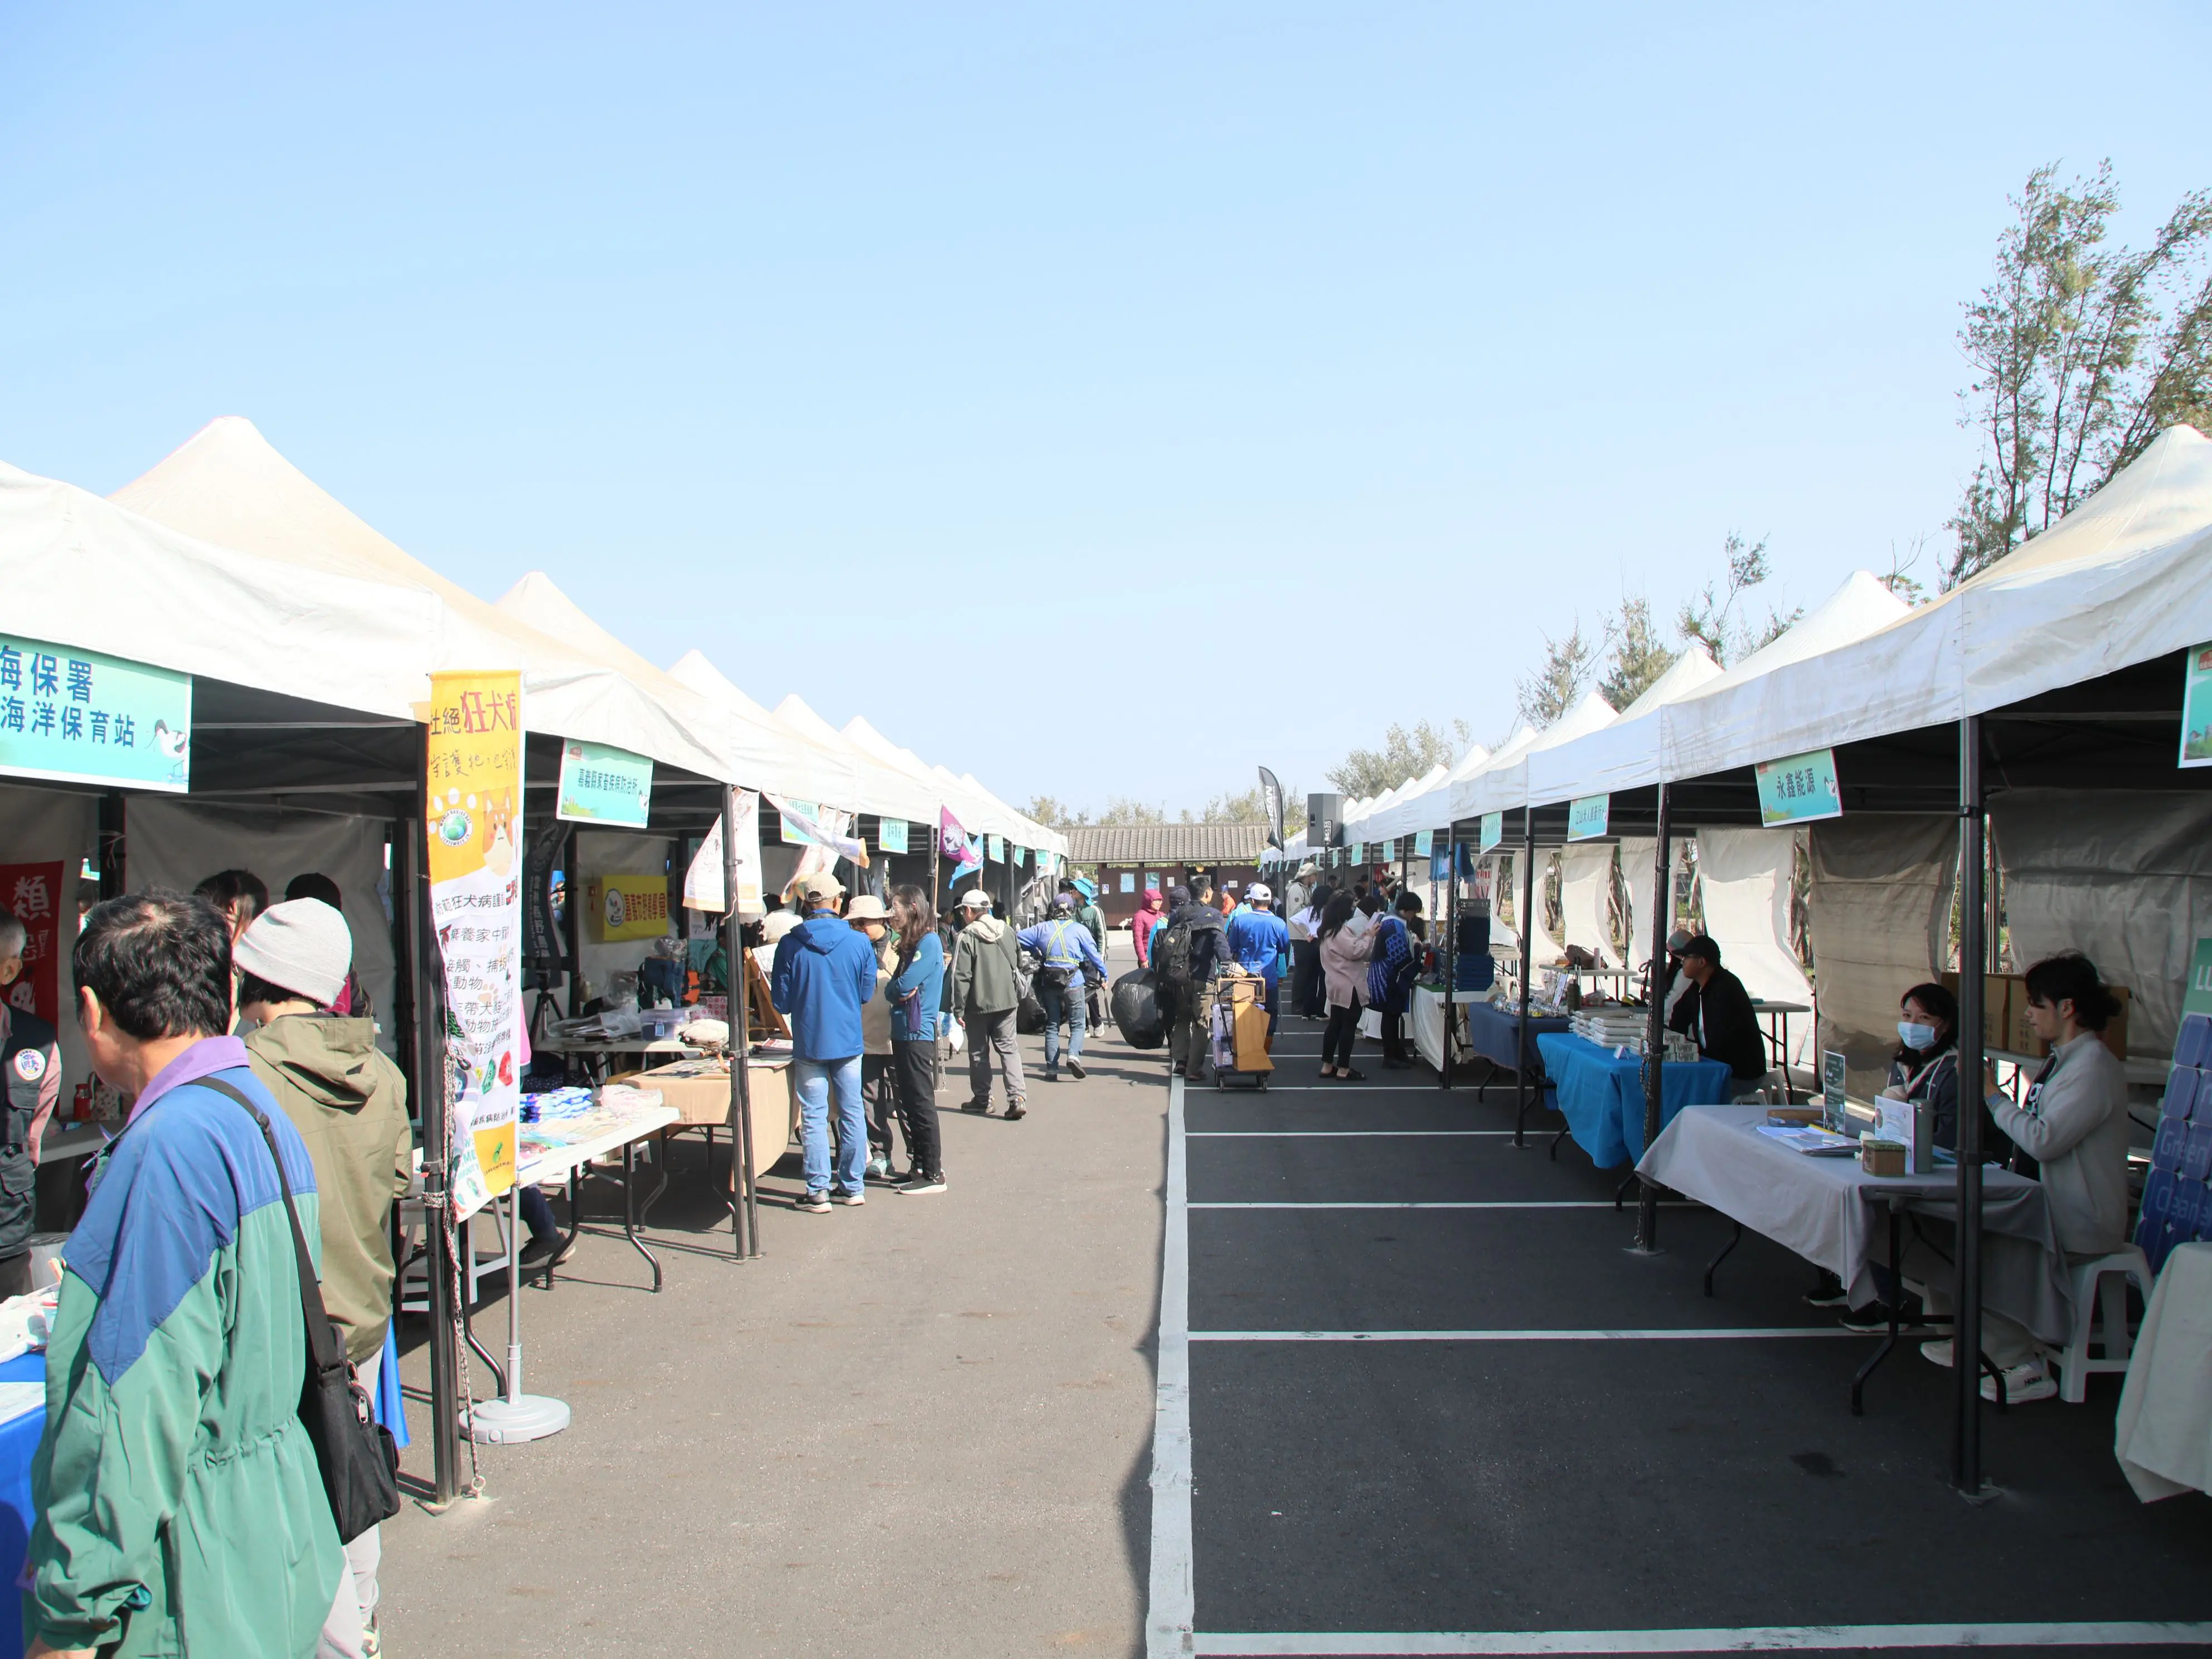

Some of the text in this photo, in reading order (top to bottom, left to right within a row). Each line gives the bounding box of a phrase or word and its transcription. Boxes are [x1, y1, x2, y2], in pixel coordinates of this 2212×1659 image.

[1, 696, 135, 748] 海洋保育站
[1776, 767, 1816, 801] 永鑫能源
